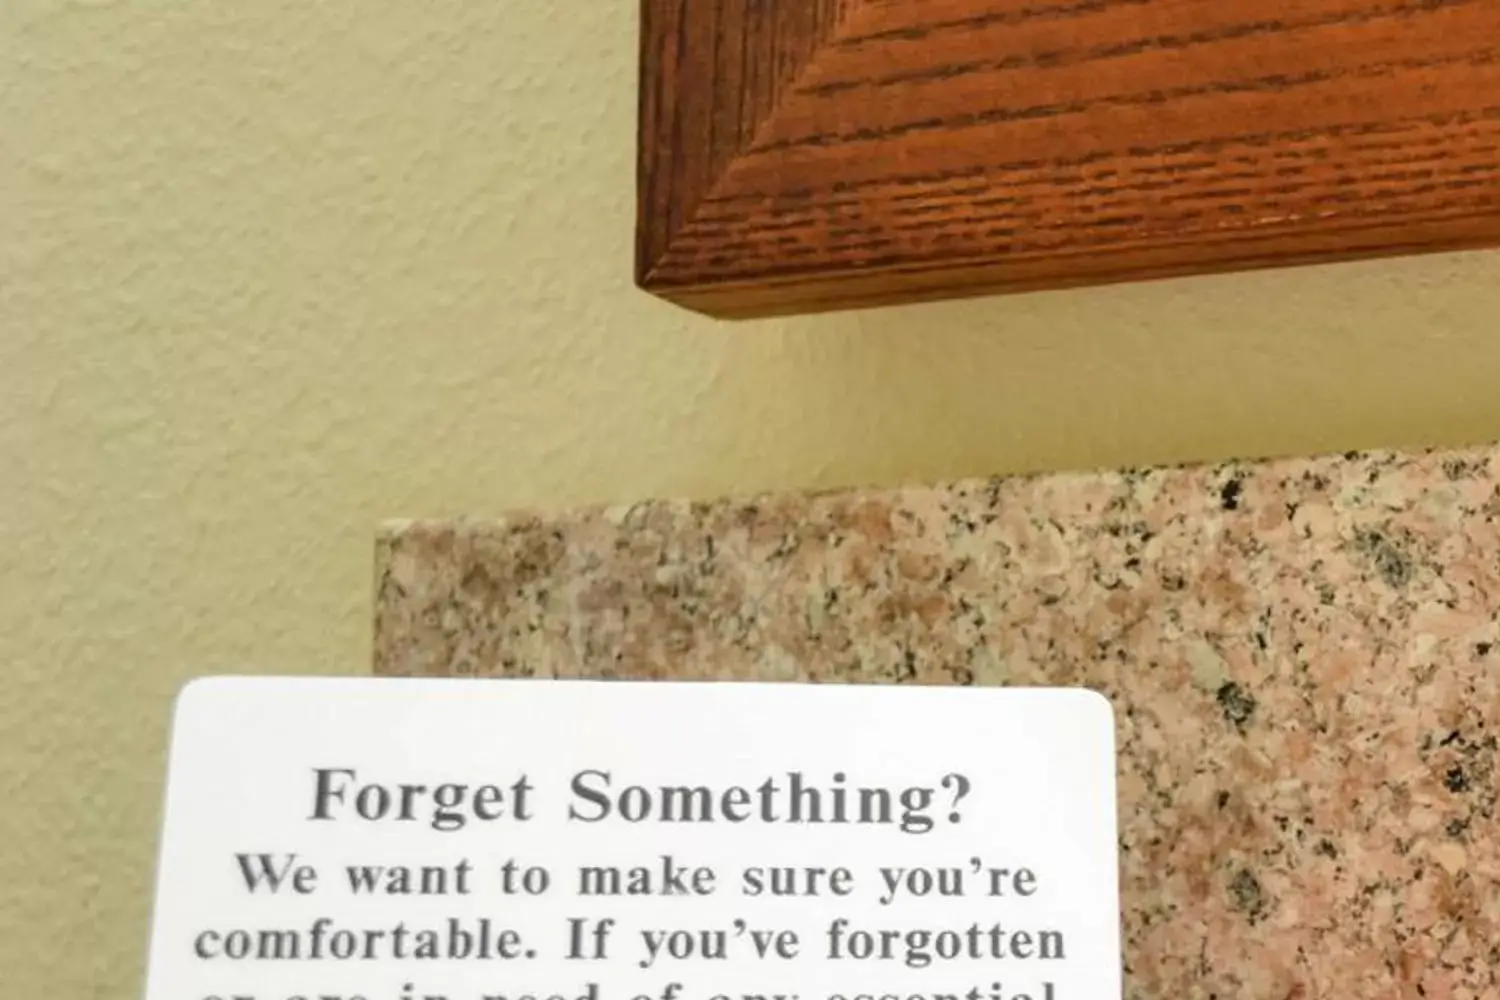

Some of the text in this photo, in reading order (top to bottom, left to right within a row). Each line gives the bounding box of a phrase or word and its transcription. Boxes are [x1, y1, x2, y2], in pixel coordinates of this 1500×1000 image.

[309, 768, 970, 835] Forget Something?
[235, 854, 318, 895] We
[346, 860, 471, 895] want
[500, 860, 550, 895] to
[578, 856, 716, 896] make
[742, 867, 853, 897] sure
[194, 917, 536, 960] comfortable.
[565, 918, 616, 960] If
[827, 919, 1065, 969] forgotten
